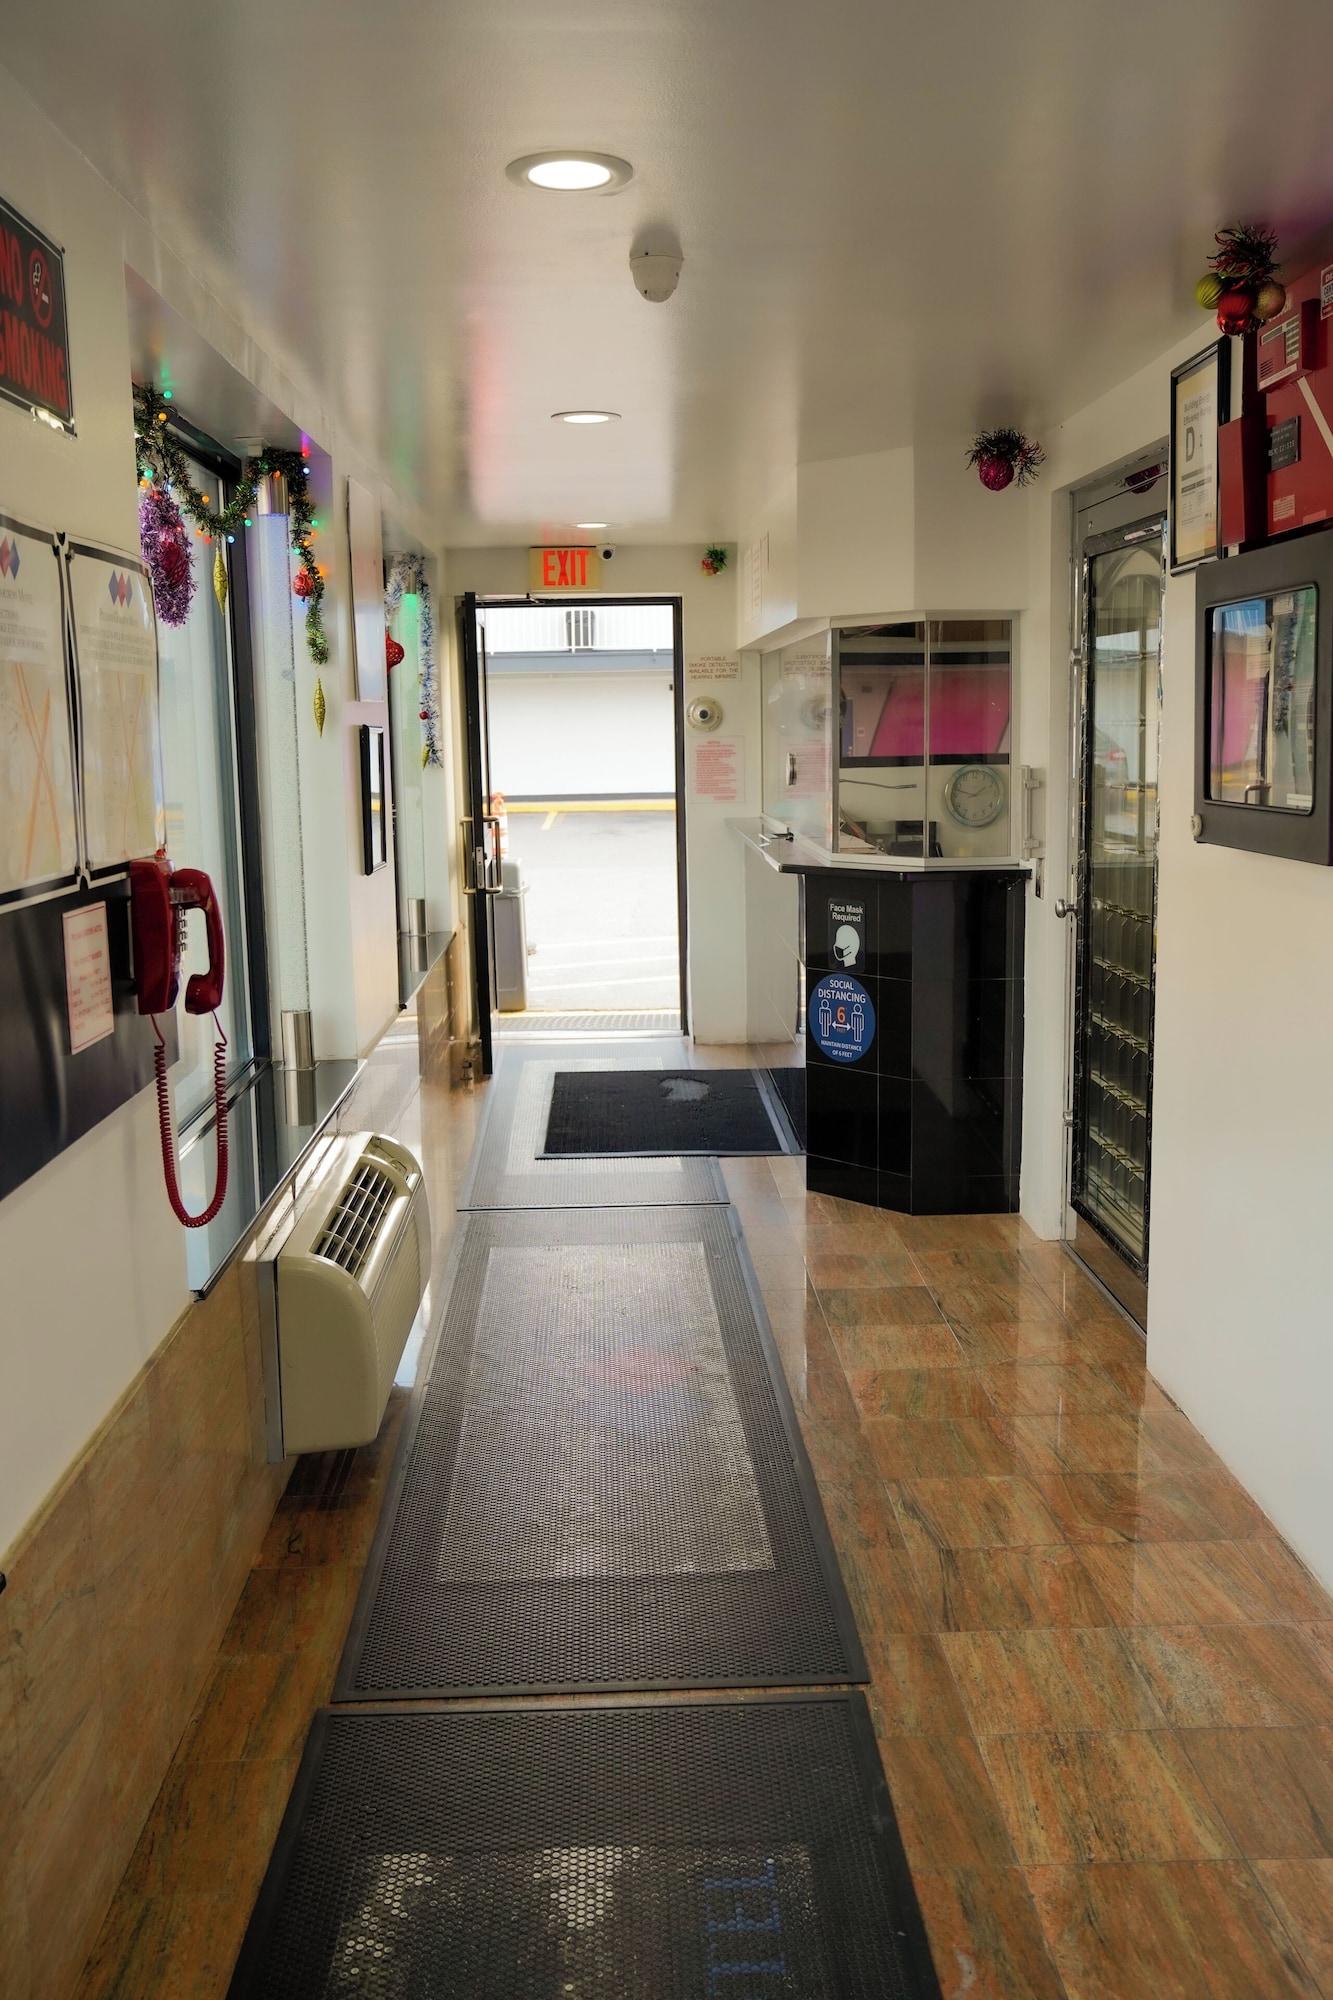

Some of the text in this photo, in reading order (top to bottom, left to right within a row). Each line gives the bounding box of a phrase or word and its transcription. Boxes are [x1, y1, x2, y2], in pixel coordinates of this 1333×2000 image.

[1186, 426, 1195, 463] D
[543, 550, 589, 586] EXIT
[830, 903, 864, 914] Face Mask
[832, 912, 861, 923] Required
[829, 979, 854, 991] SOCIAL
[818, 988, 866, 1004] DISTANCING
[841, 1042, 863, 1052] DISTANCE
